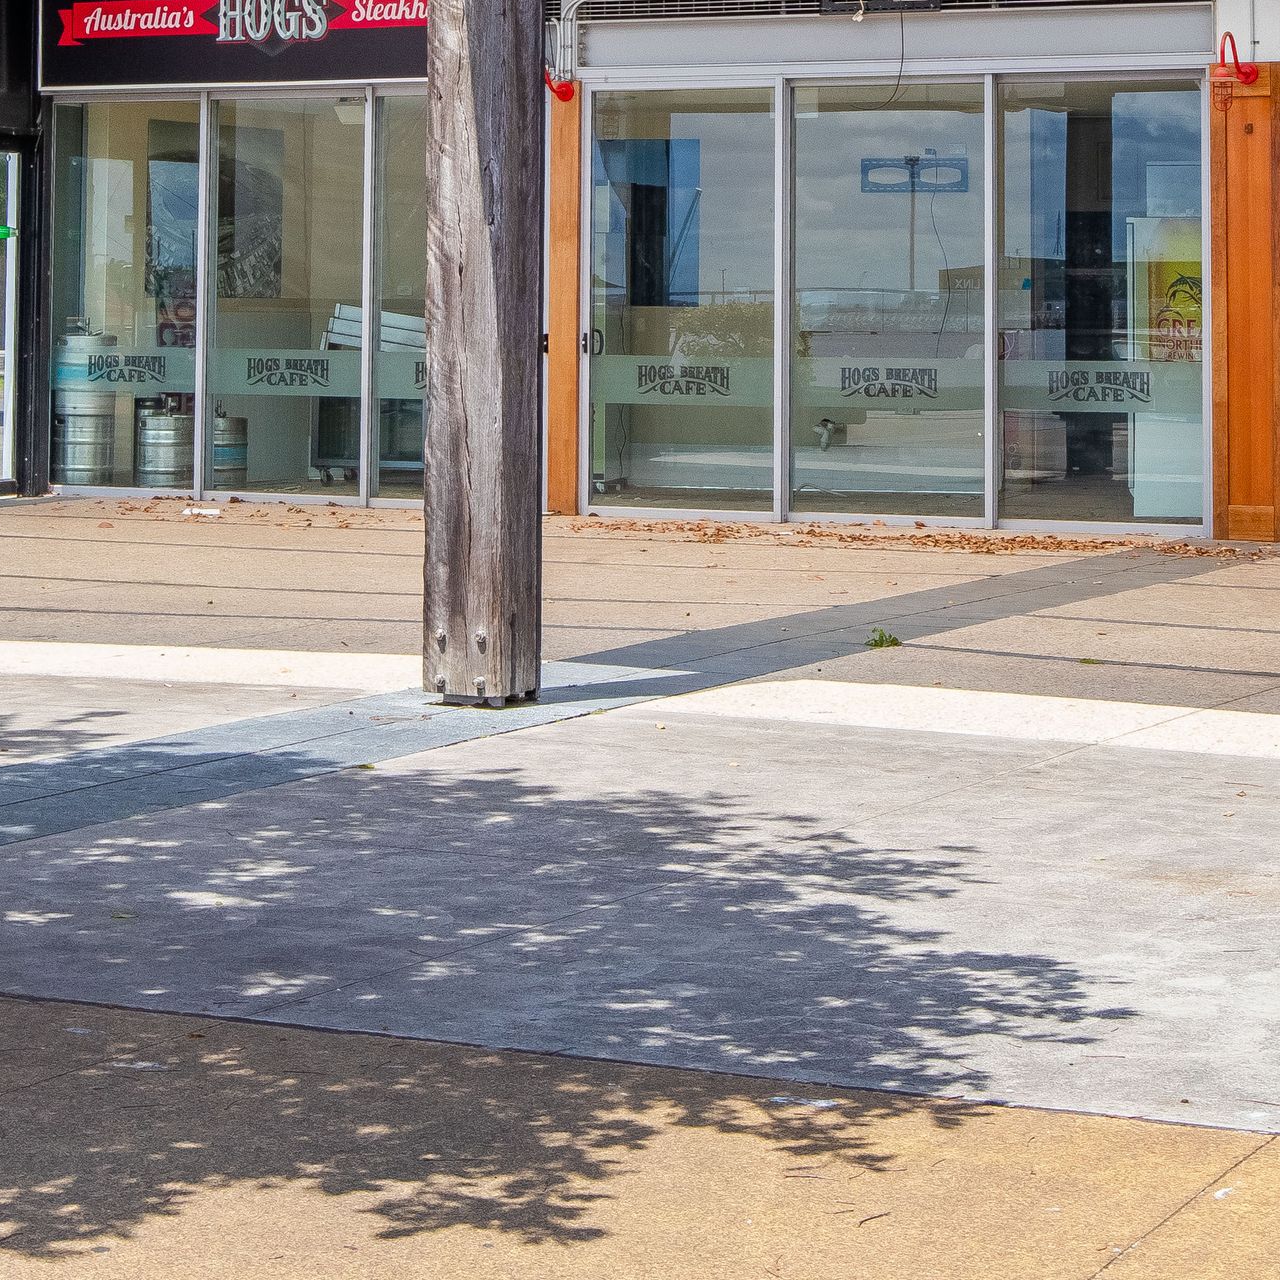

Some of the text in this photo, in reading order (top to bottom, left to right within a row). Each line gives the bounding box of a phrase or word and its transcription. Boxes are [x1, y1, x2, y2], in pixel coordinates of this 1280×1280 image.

[84, 5, 195, 34] Australia's
[1157, 318, 1202, 338] GRE
[1157, 339, 1202, 351] NORTH
[106, 368, 147, 384] CAFE
[124, 355, 166, 379] BREATH
[285, 358, 330, 382] BREATH
[266, 371, 309, 387] CAFE
[660, 380, 707, 396] CAFE
[679, 365, 730, 391] BREATH
[885, 368, 938, 393] BREATH
[1095, 370, 1151, 397] BREATH
[863, 382, 914, 398] CAFE
[1072, 386, 1125, 402] CAFE
